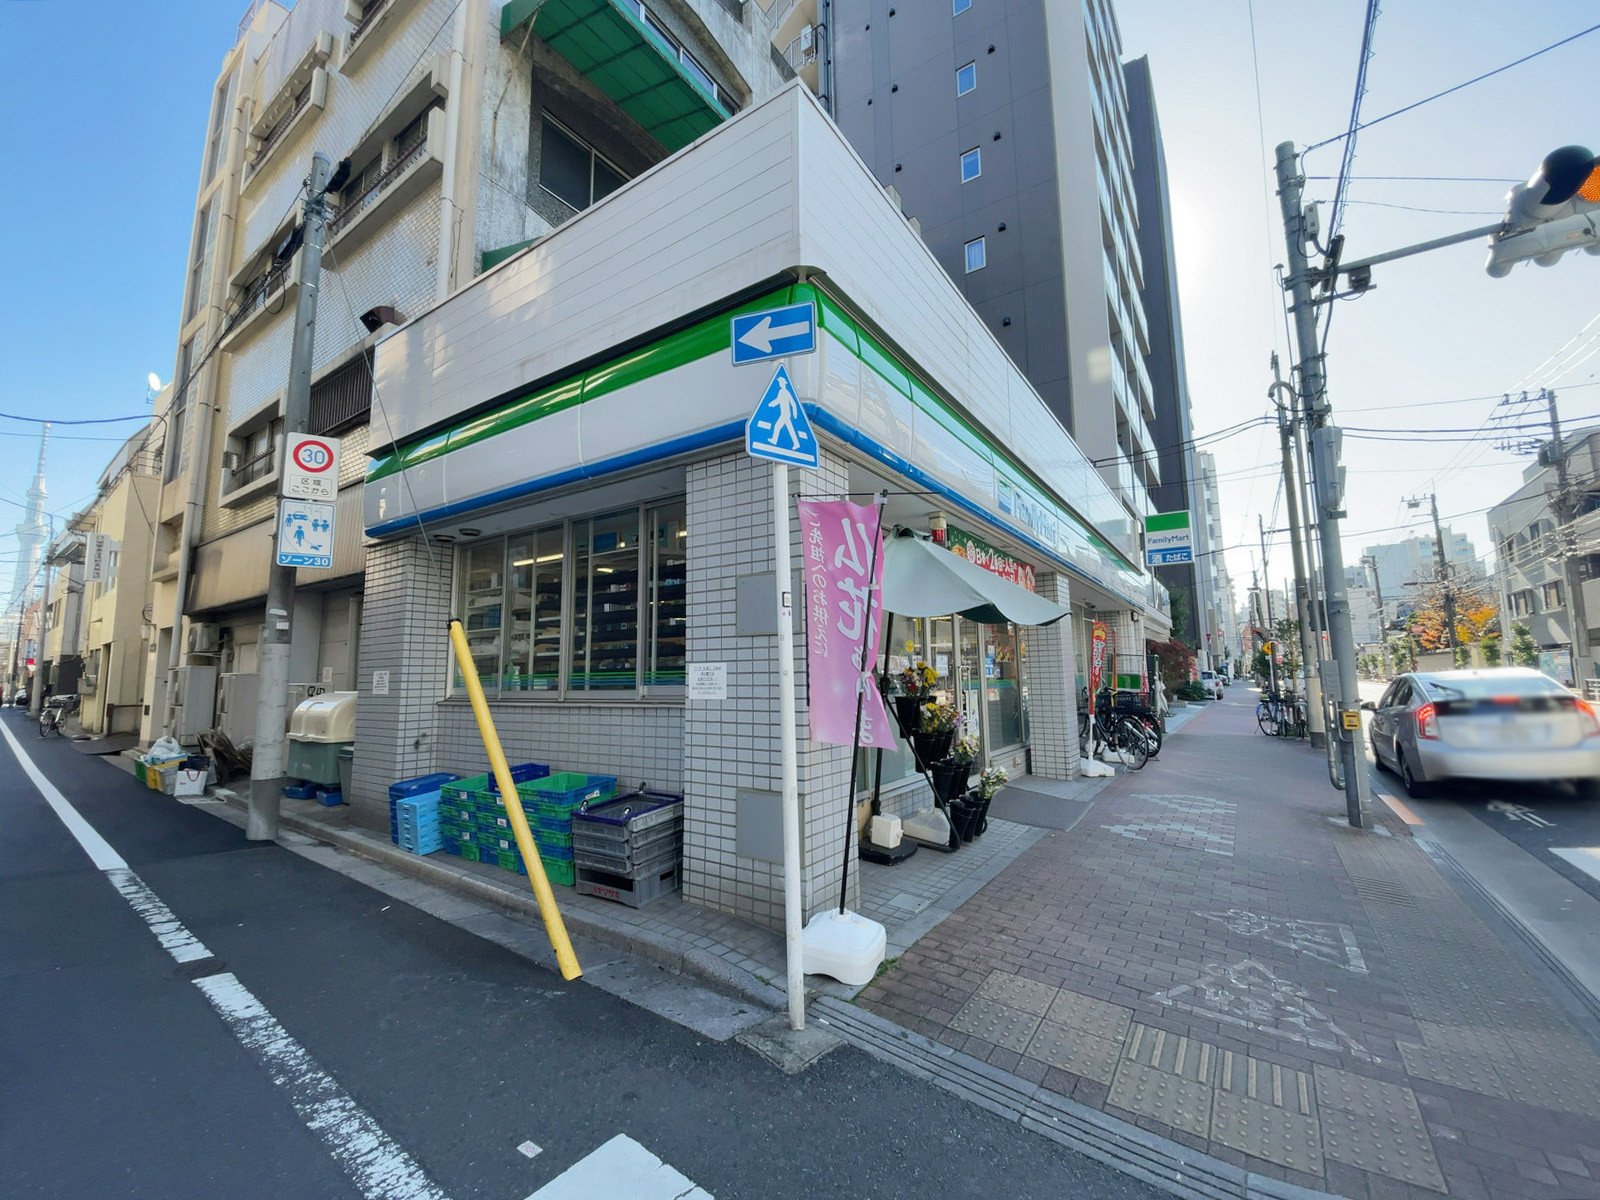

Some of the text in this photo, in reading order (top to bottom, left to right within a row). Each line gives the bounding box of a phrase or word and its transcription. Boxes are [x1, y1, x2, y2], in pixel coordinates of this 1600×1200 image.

[302, 448, 326, 465] 30
[301, 477, 322, 487] 区域
[291, 485, 330, 496] ここから
[1147, 534, 1190, 544] FamilyMart
[281, 555, 329, 567] ゾーン30
